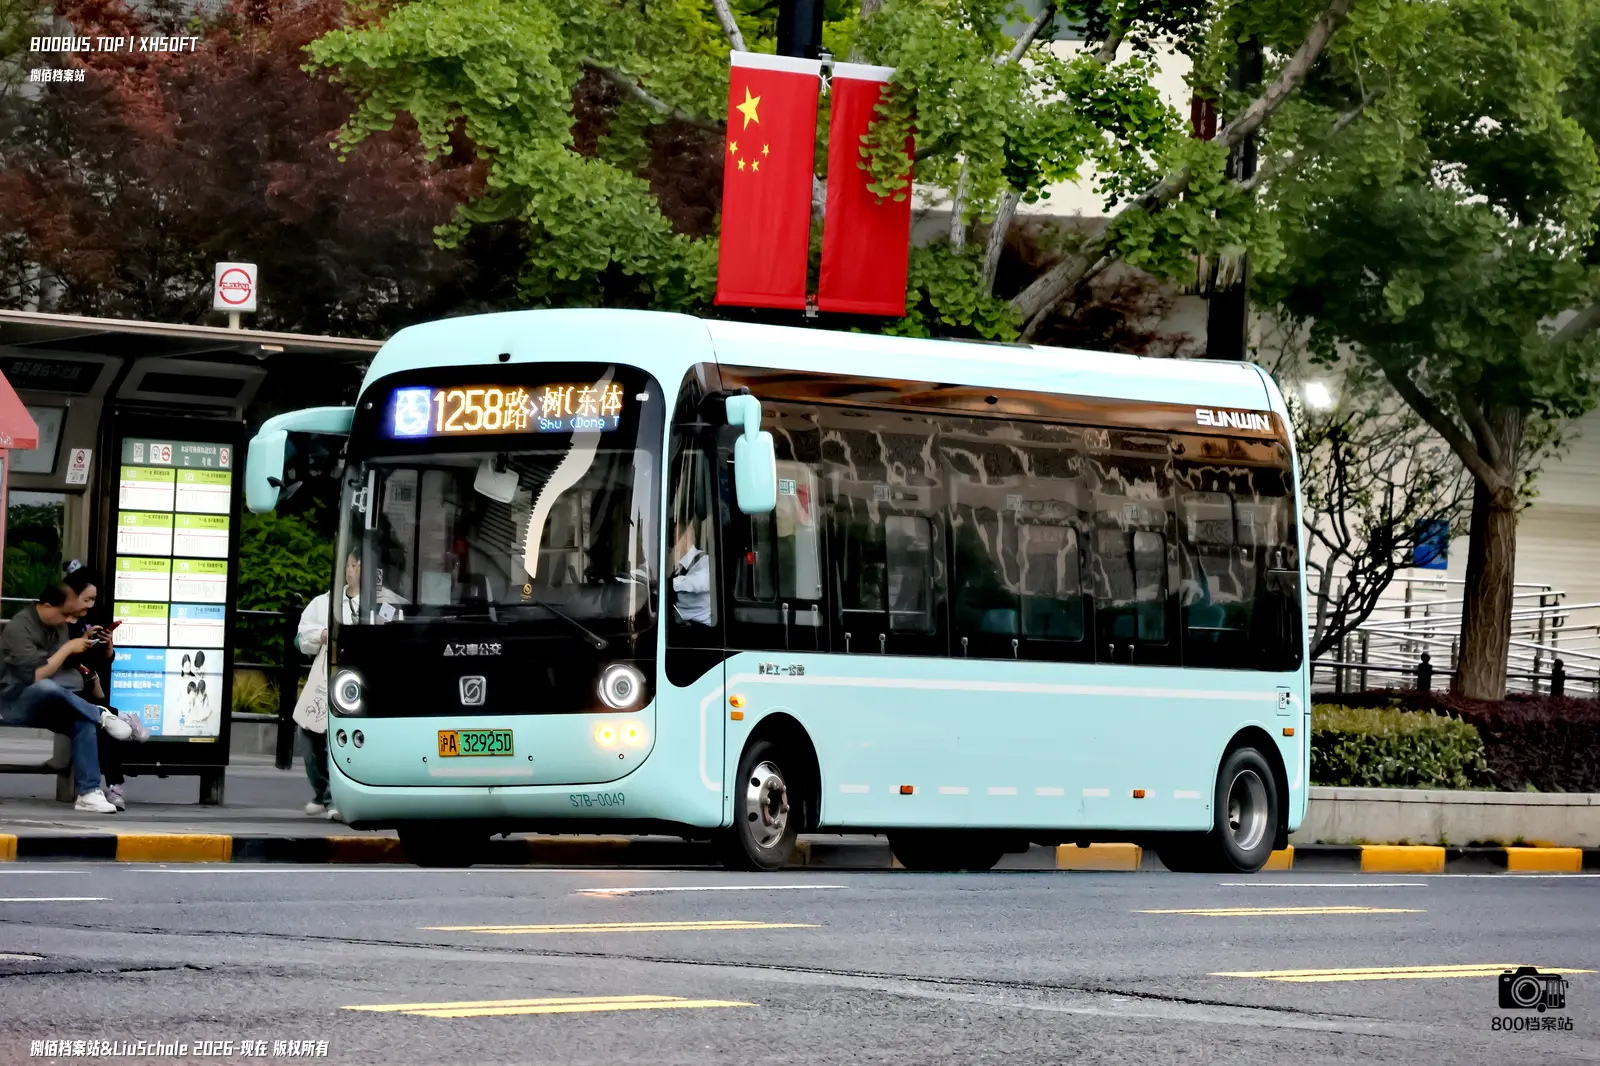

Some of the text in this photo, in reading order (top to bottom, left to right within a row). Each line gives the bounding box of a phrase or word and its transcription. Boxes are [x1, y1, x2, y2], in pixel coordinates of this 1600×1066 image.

[433, 388, 530, 431] 1258路
[540, 418, 562, 429] Shu
[1195, 408, 1271, 431] SUNWIN
[569, 792, 625, 807] S7B-0049
